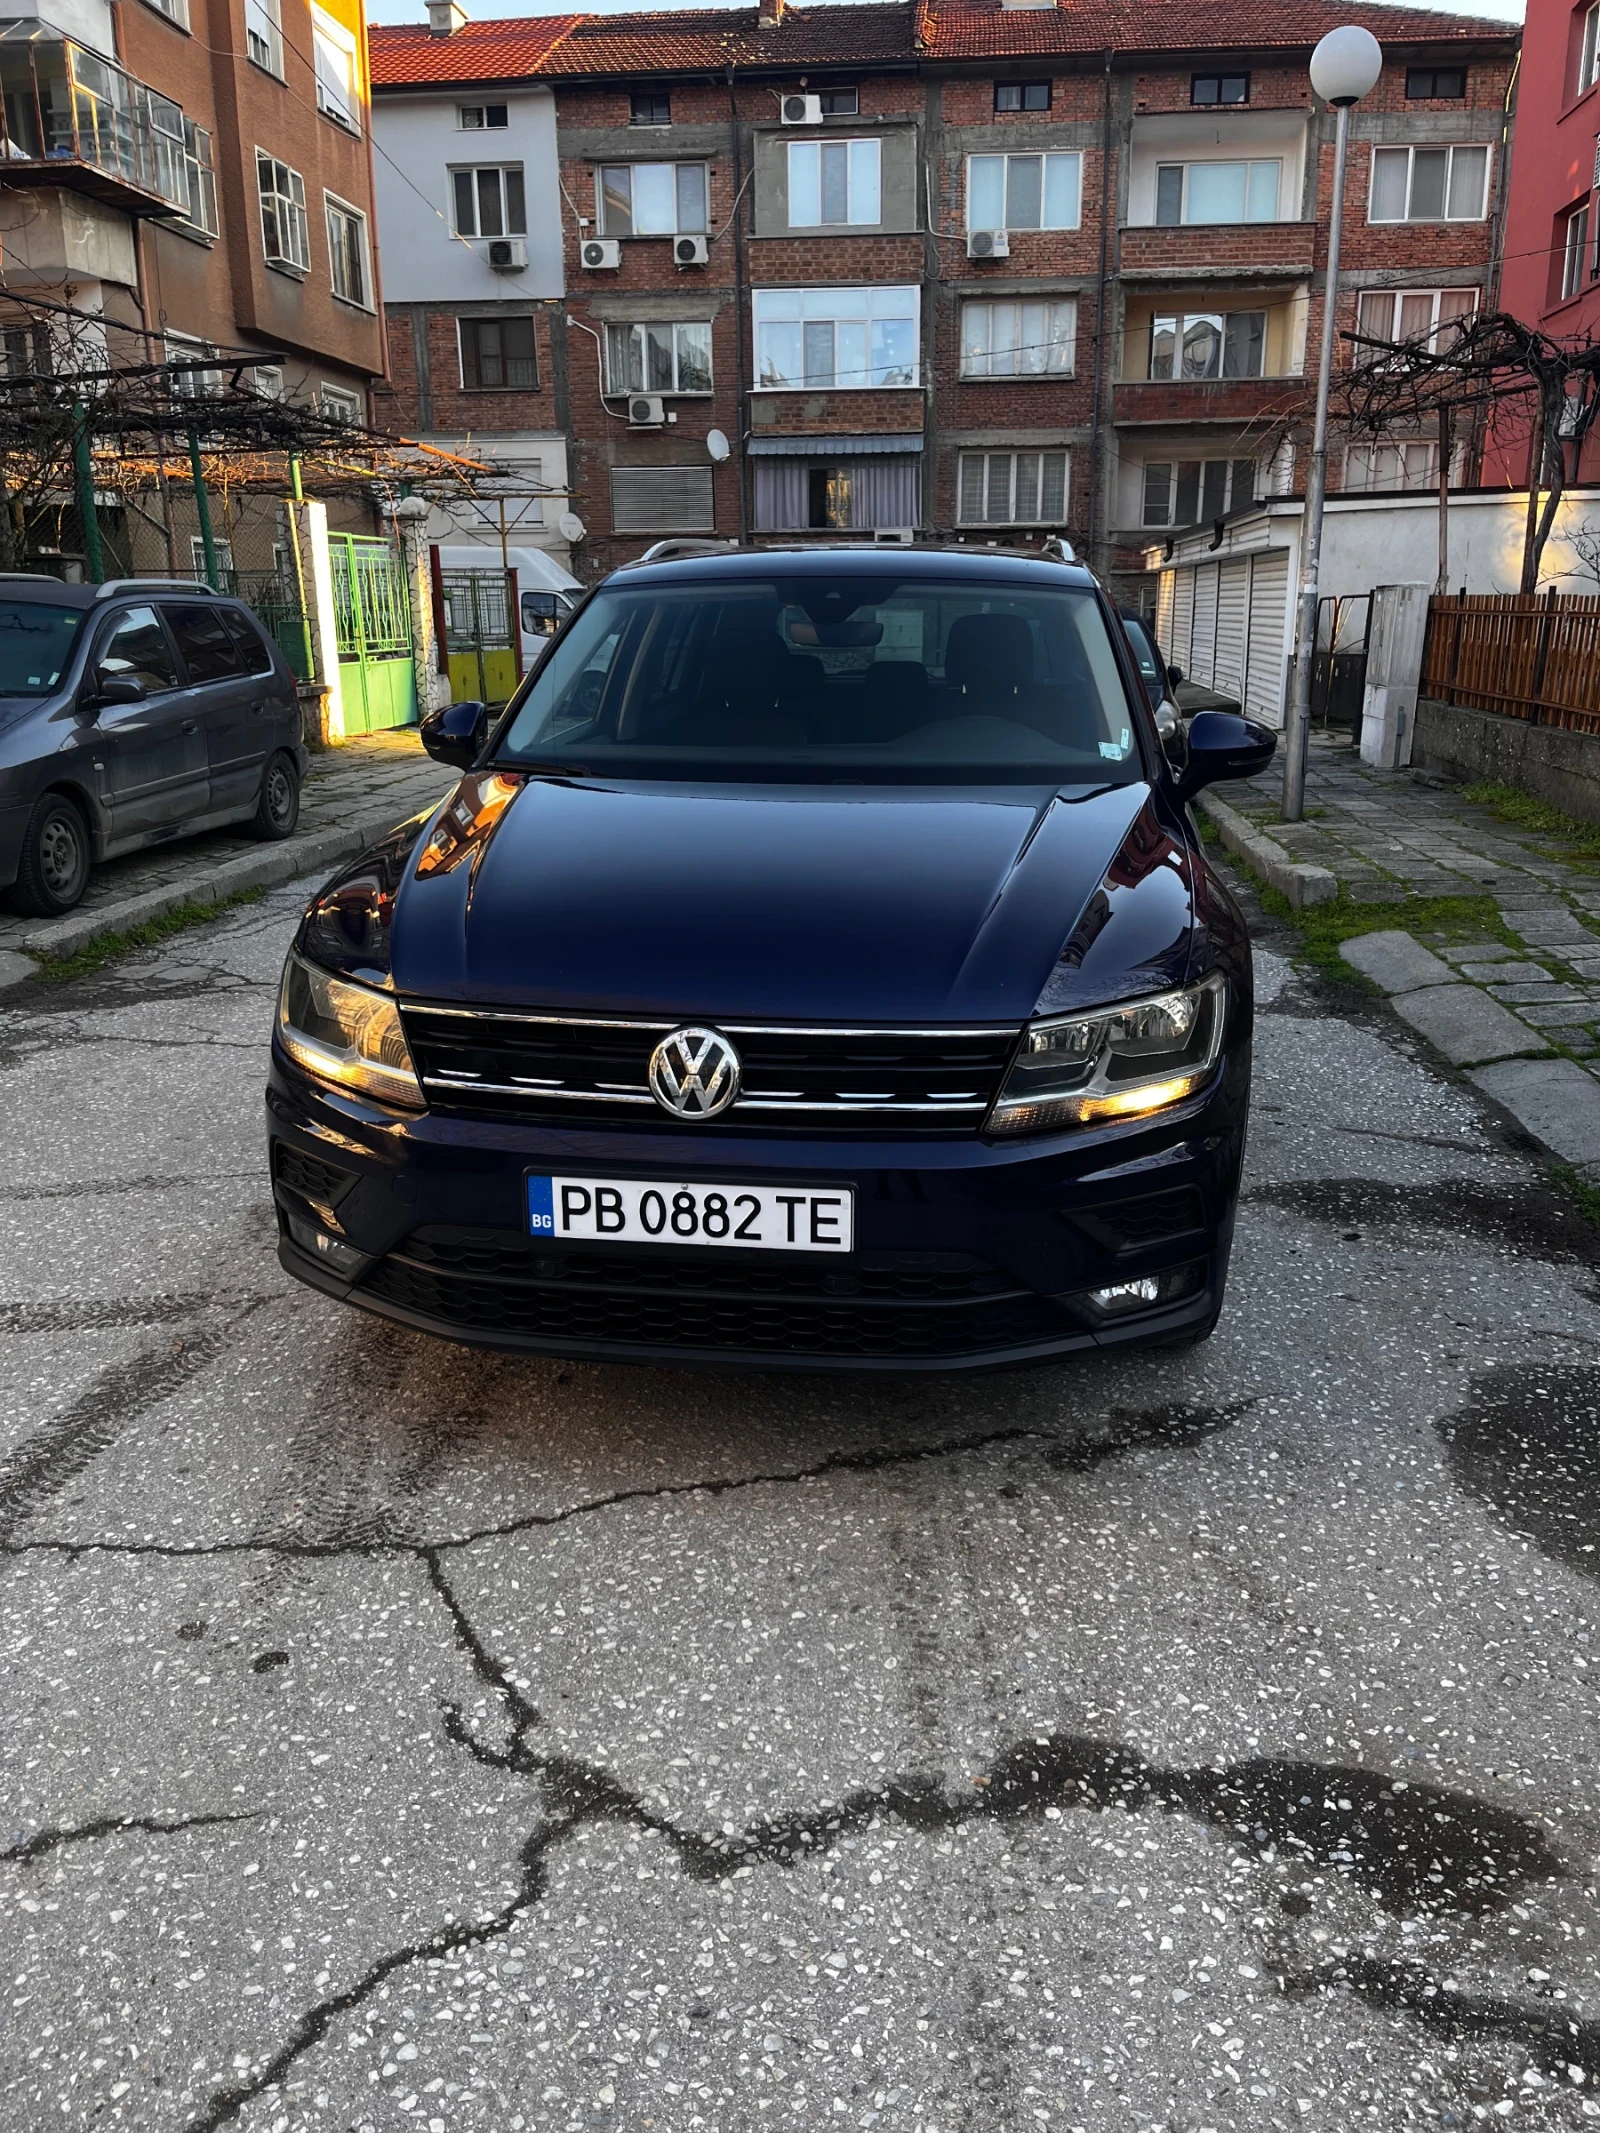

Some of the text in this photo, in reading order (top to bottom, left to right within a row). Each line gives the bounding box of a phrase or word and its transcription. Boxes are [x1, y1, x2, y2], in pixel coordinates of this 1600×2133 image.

[653, 1030, 735, 1116] VW
[532, 1213, 552, 1229] BG
[561, 1185, 841, 1244] PB 0882 TE
